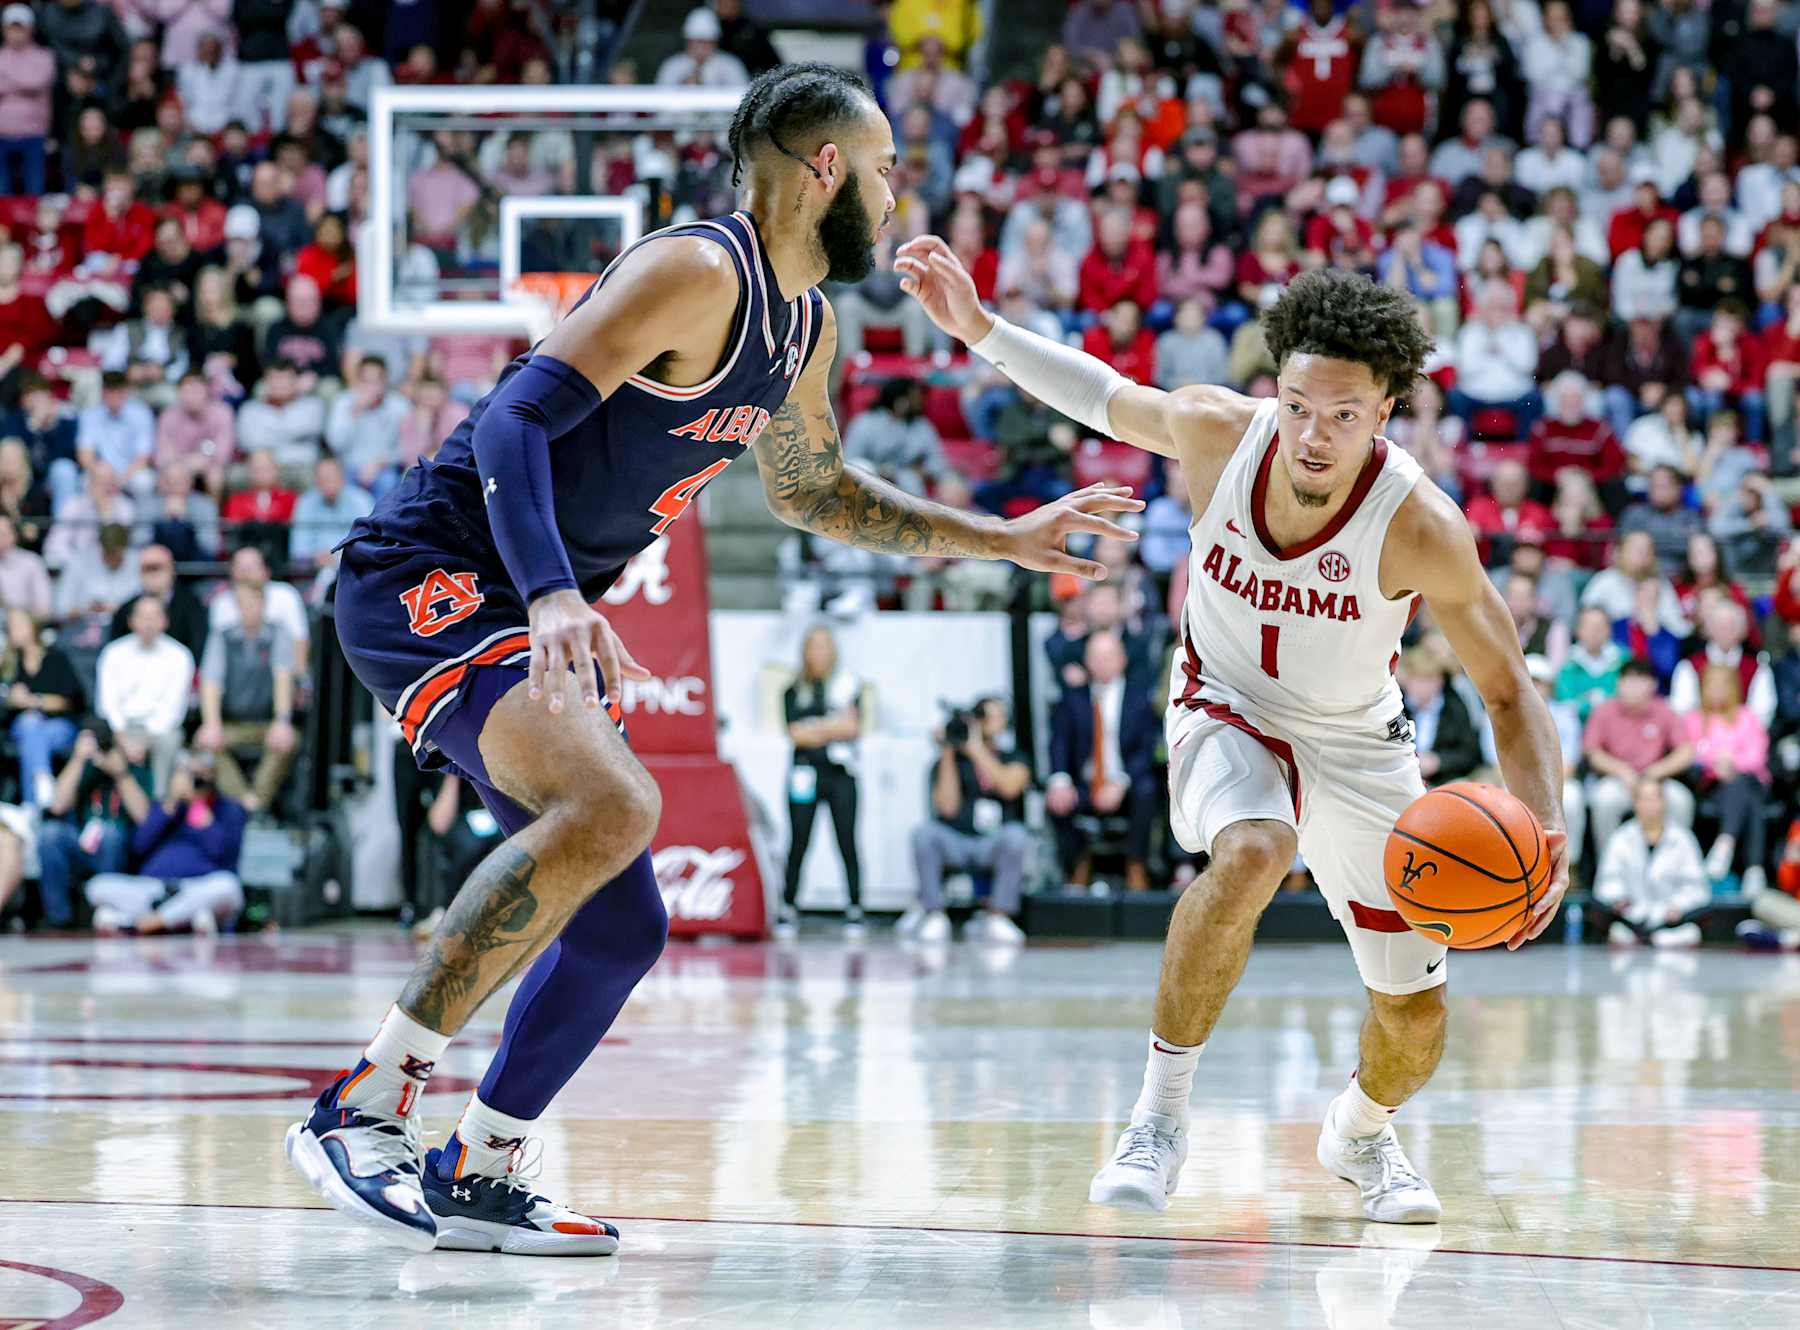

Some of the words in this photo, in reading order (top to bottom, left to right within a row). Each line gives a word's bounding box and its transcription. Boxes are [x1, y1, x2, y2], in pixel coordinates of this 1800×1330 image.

[648, 457, 733, 536] 4
[1203, 543, 1361, 622] ALABAMA
[1319, 552, 1350, 582] SEC
[1260, 624, 1280, 680] 1
